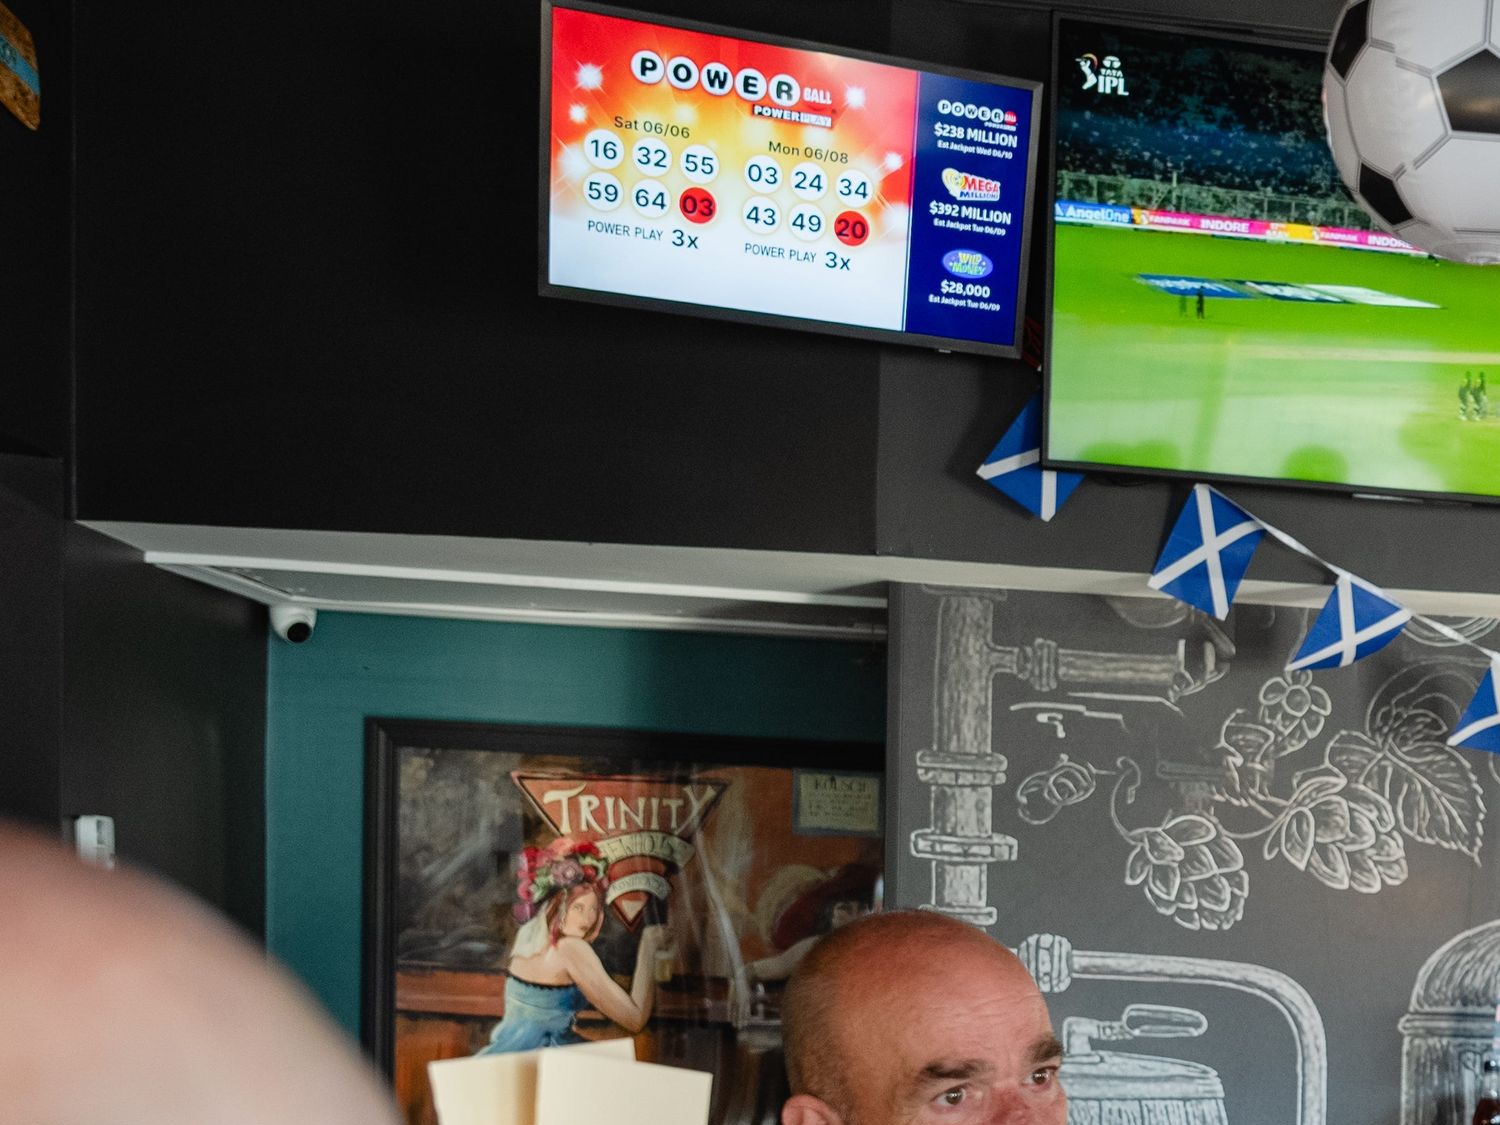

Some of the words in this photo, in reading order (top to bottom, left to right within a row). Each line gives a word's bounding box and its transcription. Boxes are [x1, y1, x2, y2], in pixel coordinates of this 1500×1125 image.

[637, 55, 795, 103] POWER
[803, 87, 832, 105] BALL
[1100, 68, 1123, 77] TATA
[1098, 75, 1129, 95] IPL
[939, 101, 1003, 122] POWER
[614, 116, 639, 131] Sat
[643, 120, 690, 139] 06/06
[934, 121, 965, 139] $238
[966, 127, 1018, 148] MILLION
[591, 139, 617, 160] 16
[637, 146, 667, 168] 32
[685, 153, 714, 175] 55
[768, 141, 800, 156] Mon
[804, 146, 849, 164] 06/08
[937, 139, 950, 149] Est
[950, 142, 976, 154] Jackpot
[976, 146, 992, 156] Wed
[992, 149, 1013, 160] 06/10
[748, 163, 778, 185] 03
[794, 171, 823, 192] 24
[839, 178, 868, 199] 34
[962, 175, 999, 193] MEGA
[588, 181, 618, 203] 59
[635, 188, 666, 210] 64
[682, 195, 713, 217] 03
[746, 206, 776, 226] 43
[792, 213, 821, 233] 49
[836, 218, 866, 240] 20
[929, 200, 960, 217] $392
[961, 205, 1012, 225] MILLION
[1066, 206, 1130, 224] AngelOne
[588, 220, 630, 236] POWER
[635, 226, 664, 241] PLAY
[671, 229, 699, 249] 3x
[933, 217, 946, 227] Est
[946, 219, 972, 232] Jackpot
[972, 223, 984, 233] Tue
[984, 226, 1006, 237] 06/09
[1201, 218, 1249, 233] INDORE
[744, 242, 785, 259] POWER
[789, 249, 817, 263] PLAY
[825, 251, 851, 271] 3x
[941, 279, 991, 298] $28,000
[928, 294, 940, 303] Est
[940, 295, 966, 307] Jackpot
[967, 299, 979, 309] Tue
[979, 301, 1001, 312] 06/09
[543, 781, 718, 836] TRINITY
